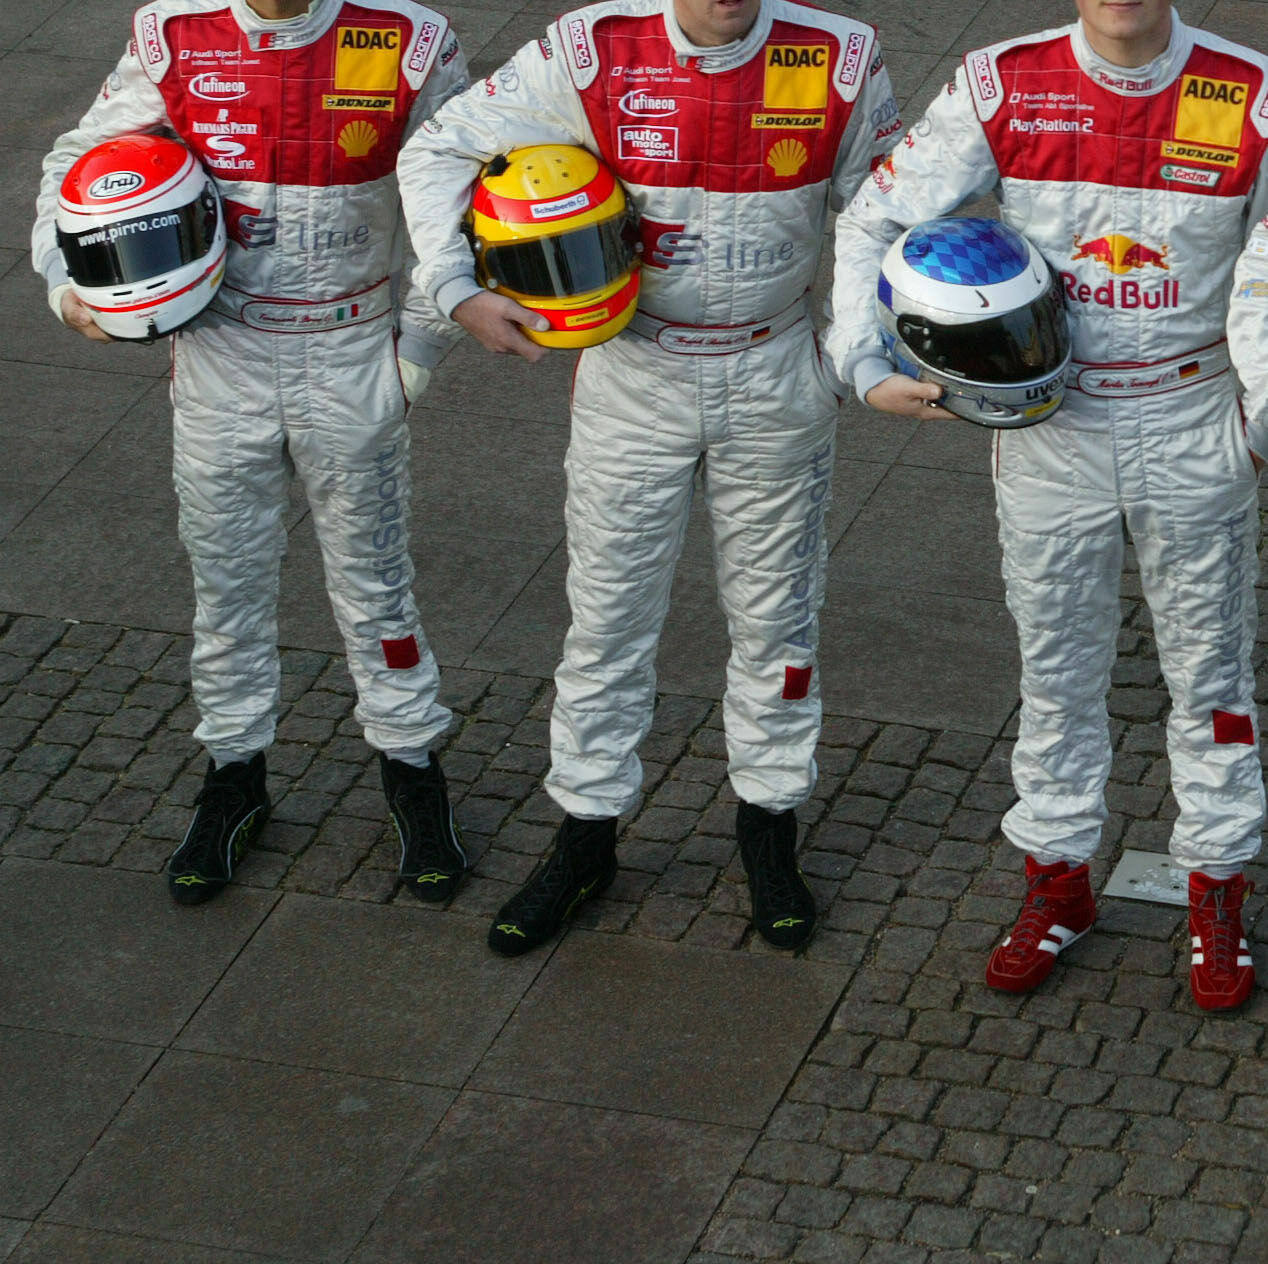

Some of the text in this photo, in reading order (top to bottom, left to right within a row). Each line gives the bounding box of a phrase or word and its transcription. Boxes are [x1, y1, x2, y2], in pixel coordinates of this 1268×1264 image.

[142, 13, 162, 65] sparco
[341, 29, 398, 50] ADAC
[408, 22, 439, 73] sparco
[570, 19, 592, 69] sparco
[768, 47, 826, 68] ADAC
[839, 33, 864, 86] sparco
[199, 76, 246, 93] Infineon
[974, 54, 995, 99] sparco
[1099, 72, 1153, 91] Red Bull
[335, 98, 392, 108] DUNLOP
[629, 93, 676, 110] Infineon
[1184, 80, 1244, 106] ADAC
[763, 116, 823, 126] DUNLOP
[1009, 118, 1094, 134] PlayStation 2
[623, 129, 662, 142] auto
[632, 140, 670, 149] motor
[644, 148, 673, 158] sport
[1175, 147, 1235, 163] DUNLOP
[1173, 168, 1211, 183] Castrol
[77, 213, 182, 248] www.pirro.com
[299, 223, 369, 250] line
[726, 240, 795, 270] line
[1058, 270, 1180, 309] Red Bull
